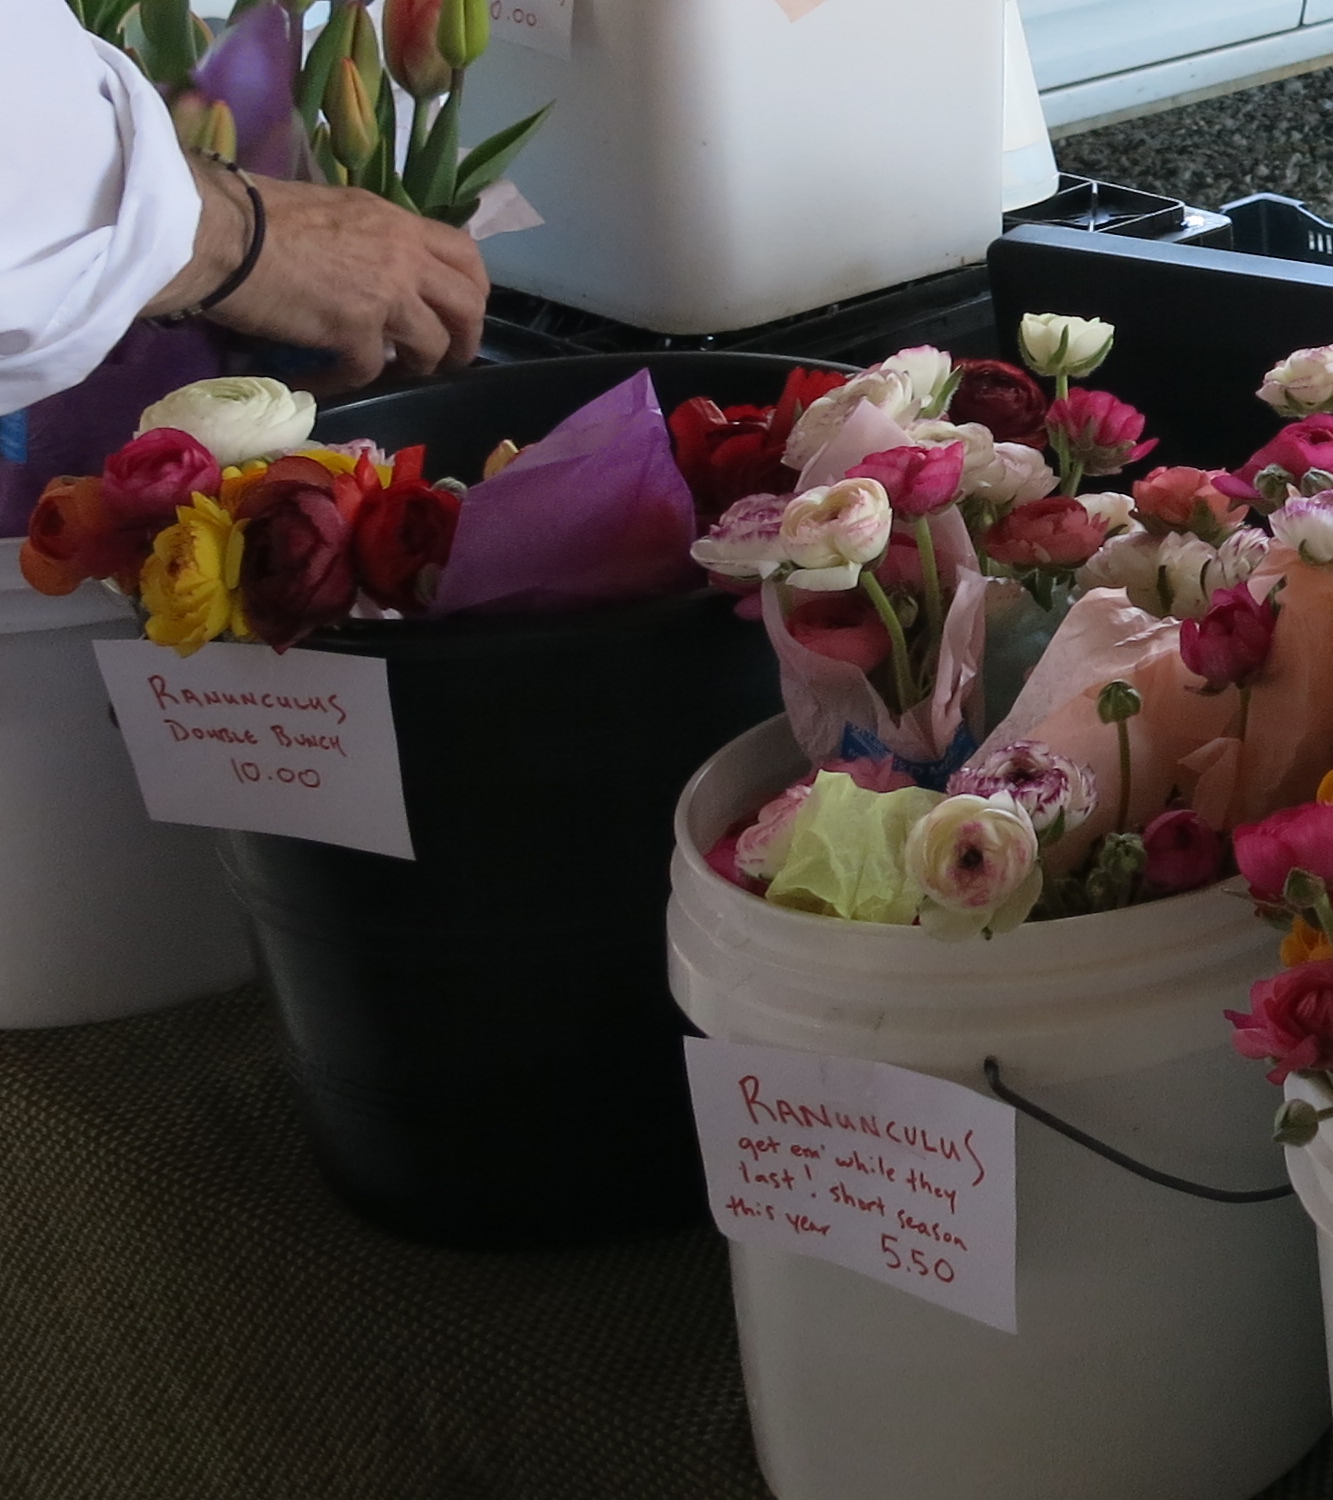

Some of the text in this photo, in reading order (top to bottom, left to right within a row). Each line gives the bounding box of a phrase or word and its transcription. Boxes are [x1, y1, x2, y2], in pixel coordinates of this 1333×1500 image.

[490, 0, 537, 27] 0.00
[230, 757, 321, 788] 10.00
[738, 1135, 781, 1161] get
[835, 1150, 896, 1183] while
[906, 1169, 957, 1215] they
[726, 1195, 831, 1237] this year
[829, 1181, 885, 1216] short
[896, 1208, 968, 1252] season
[881, 1233, 955, 1284] 5.50
